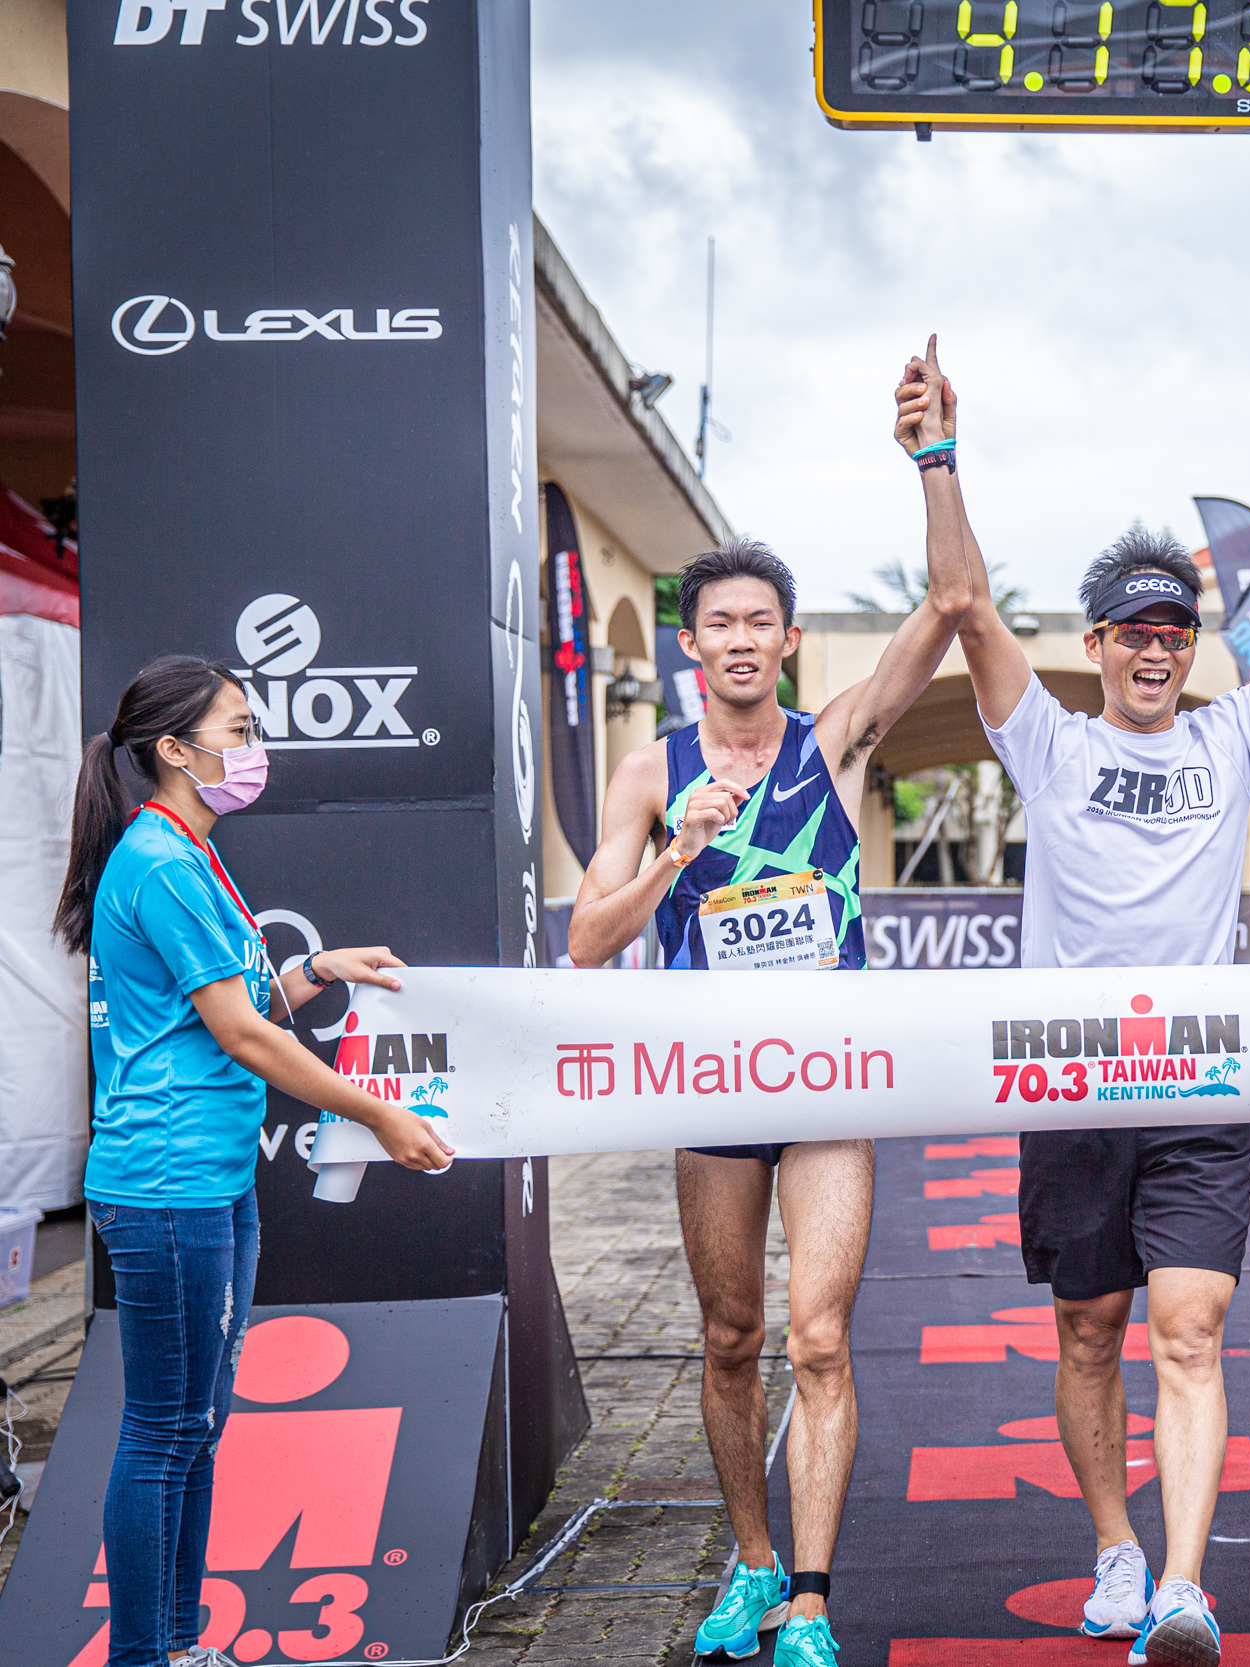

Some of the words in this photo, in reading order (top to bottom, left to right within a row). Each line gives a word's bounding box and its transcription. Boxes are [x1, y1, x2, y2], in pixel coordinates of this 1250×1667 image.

[113, 0, 225, 45] DT
[236, 0, 428, 46] SWISS
[203, 308, 443, 340] LEXUS
[1086, 806, 1104, 815] 2019
[1168, 810, 1220, 824] CHAMPIONSHIP
[742, 885, 777, 898] IRONMAN
[790, 884, 814, 896] TWN
[719, 903, 815, 946] 3024
[868, 914, 1018, 968] SWISS
[992, 994, 1240, 1059] IRONMAN
[634, 1037, 895, 1095] MaiCoin
[993, 1062, 1089, 1103] 70.3
[1098, 1058, 1196, 1083] TAIWAN
[1098, 1085, 1176, 1101] KENTING
